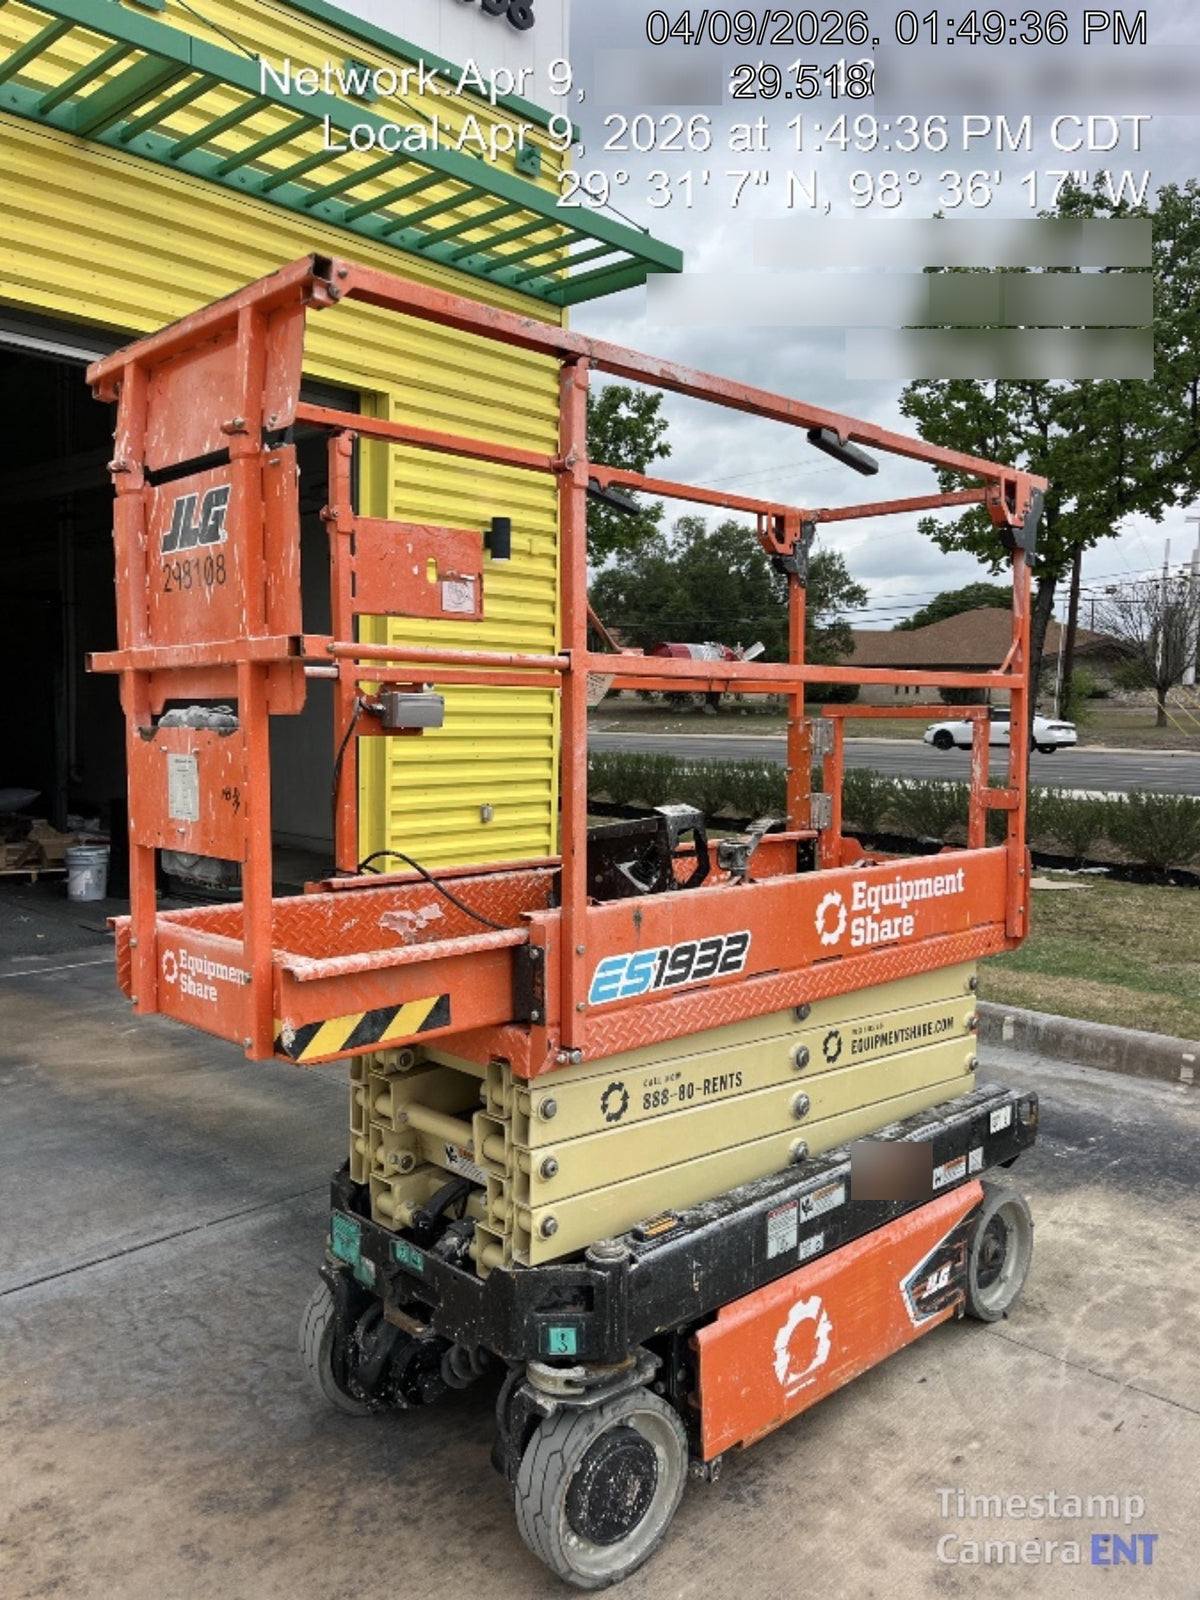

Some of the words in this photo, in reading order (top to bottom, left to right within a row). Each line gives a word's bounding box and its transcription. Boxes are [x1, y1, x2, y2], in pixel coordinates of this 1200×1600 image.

[161, 484, 231, 555] JLG
[851, 869, 965, 914] Equipment
[851, 914, 915, 948] Share
[179, 949, 250, 985] Equipmen
[588, 929, 751, 1004] ES1932
[180, 973, 218, 1002] Share
[851, 1016, 954, 1055] EQUIPMENTSHARE.COM
[643, 1071, 742, 1110] 888-80-RENTS
